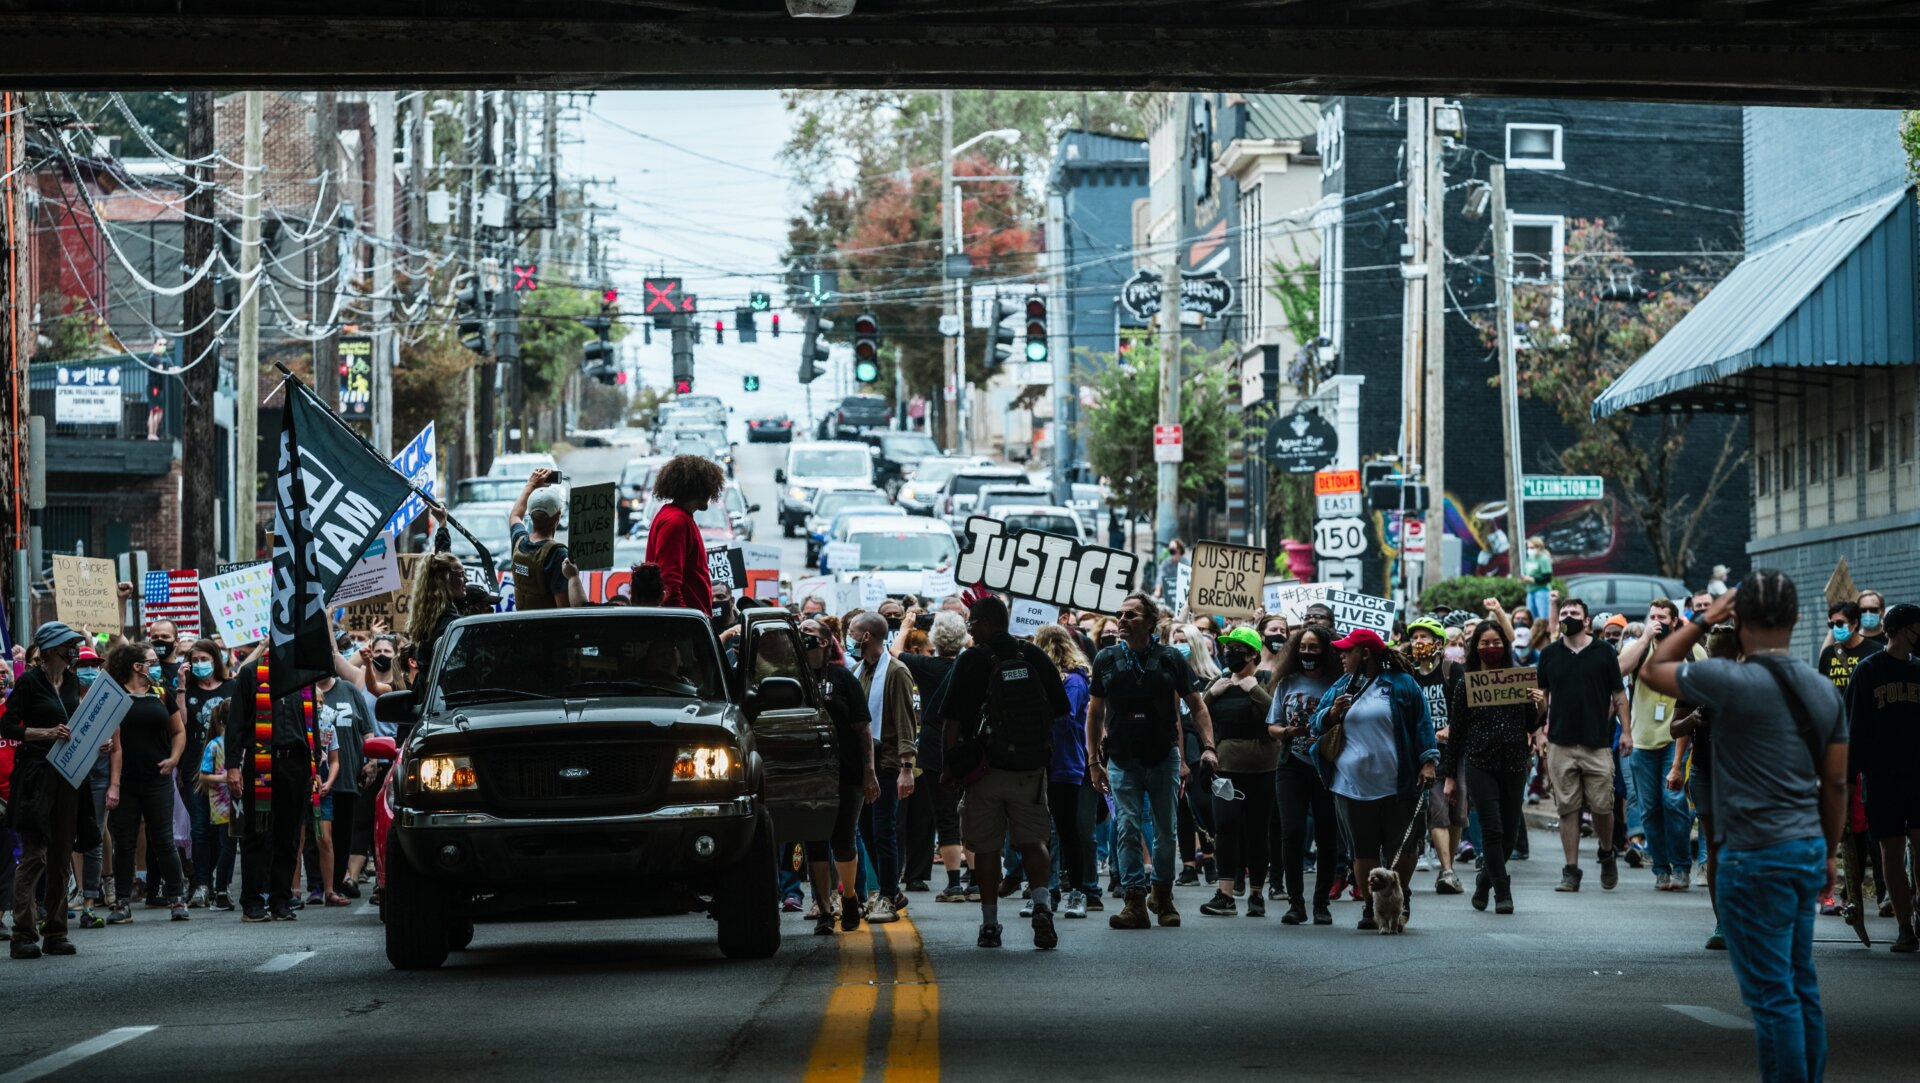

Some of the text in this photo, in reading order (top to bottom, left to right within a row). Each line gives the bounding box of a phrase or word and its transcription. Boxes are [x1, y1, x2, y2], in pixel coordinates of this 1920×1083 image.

[1319, 474, 1355, 490] DETOUR
[1530, 480, 1588, 495] LEXINGTON
[572, 492, 615, 516] BLACK
[1324, 498, 1353, 510] EAST
[573, 516, 610, 536] LIVES
[1320, 526, 1360, 551] 150
[570, 540, 610, 558] MATTER
[708, 550, 728, 567] ACK
[957, 516, 1134, 614] JUSTICE
[1198, 545, 1263, 573] JUSTICE
[708, 564, 730, 580] VES
[94, 577, 104, 587] IS
[1214, 570, 1246, 592] FOR
[62, 587, 109, 597] TO BECOME
[226, 583, 271, 603] ANYWH
[1198, 587, 1256, 611] BREONNA
[1334, 591, 1387, 612] BLACK
[75, 610, 87, 618] TO
[1027, 606, 1043, 616] FOR
[1331, 604, 1386, 627] LIVES
[226, 618, 243, 630] TO
[1831, 656, 1860, 667] BLCK
[1002, 669, 1028, 681] PRESS
[1470, 669, 1537, 688] NO JUSTICE
[1423, 683, 1445, 699] ACK
[1472, 689, 1492, 704] NO
[1873, 681, 1920, 709] TOLE
[60, 736, 81, 769] JUSTICE
[79, 720, 92, 737] FOR
